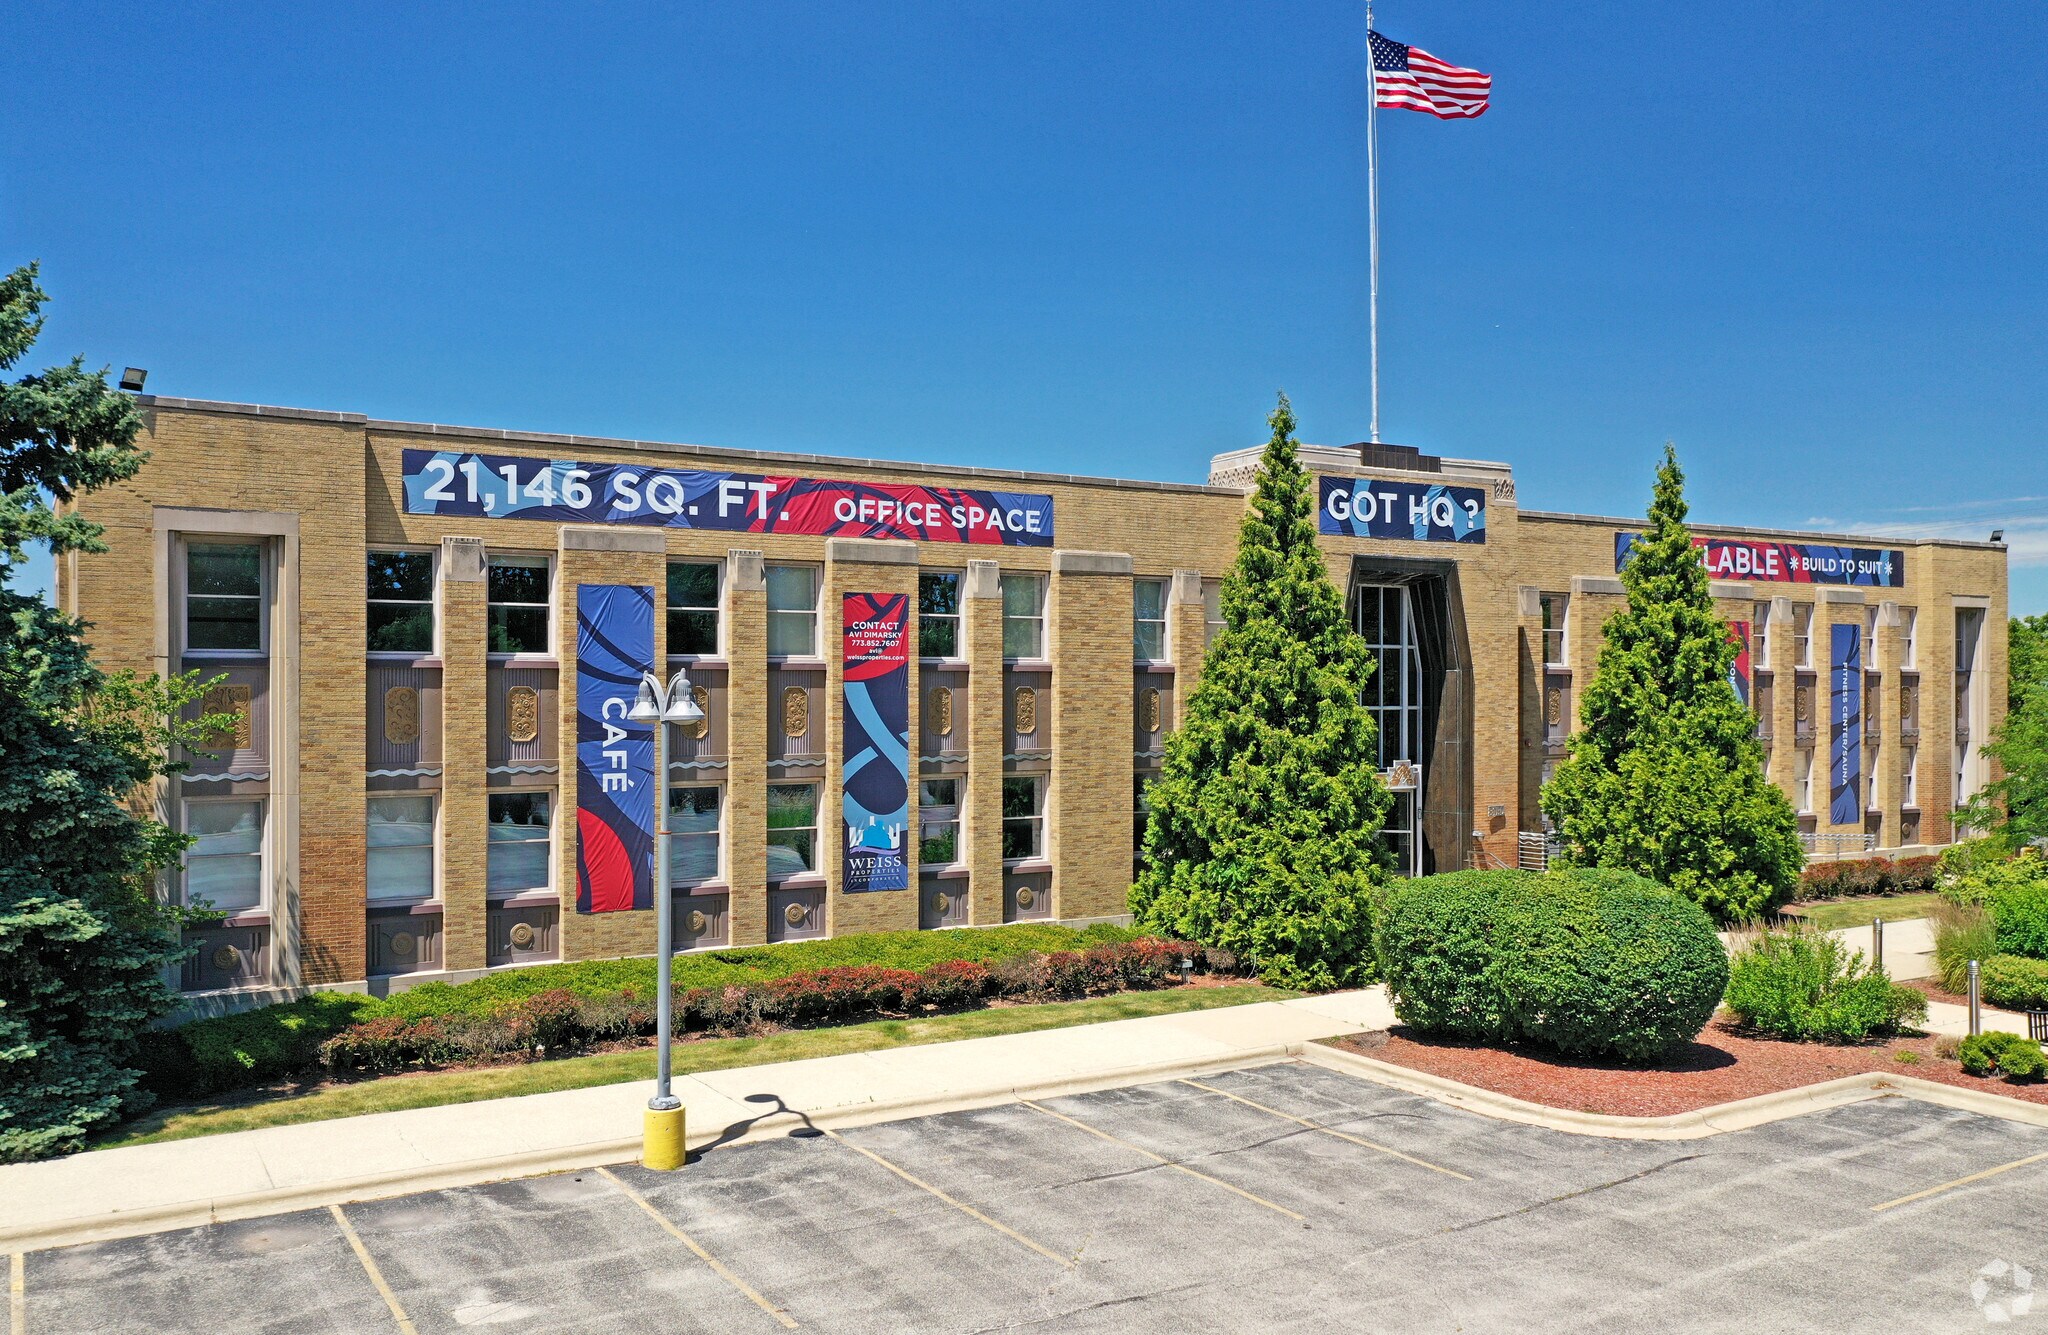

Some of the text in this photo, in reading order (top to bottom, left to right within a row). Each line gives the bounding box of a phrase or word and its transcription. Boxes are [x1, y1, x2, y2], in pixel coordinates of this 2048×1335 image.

[424, 459, 790, 521] 21,146 SQ. FT.
[833, 497, 1042, 533] OFFICE SPACE
[1327, 488, 1479, 529] GOT HQ ?
[1802, 557, 1883, 575] BUILD TO SUIT
[852, 621, 899, 630] CONTACT
[851, 639, 900, 647] 773.852.7607
[863, 631, 903, 639] DIMARSKY
[602, 697, 635, 793] CAFÉ
[849, 856, 901, 869] WEISS
